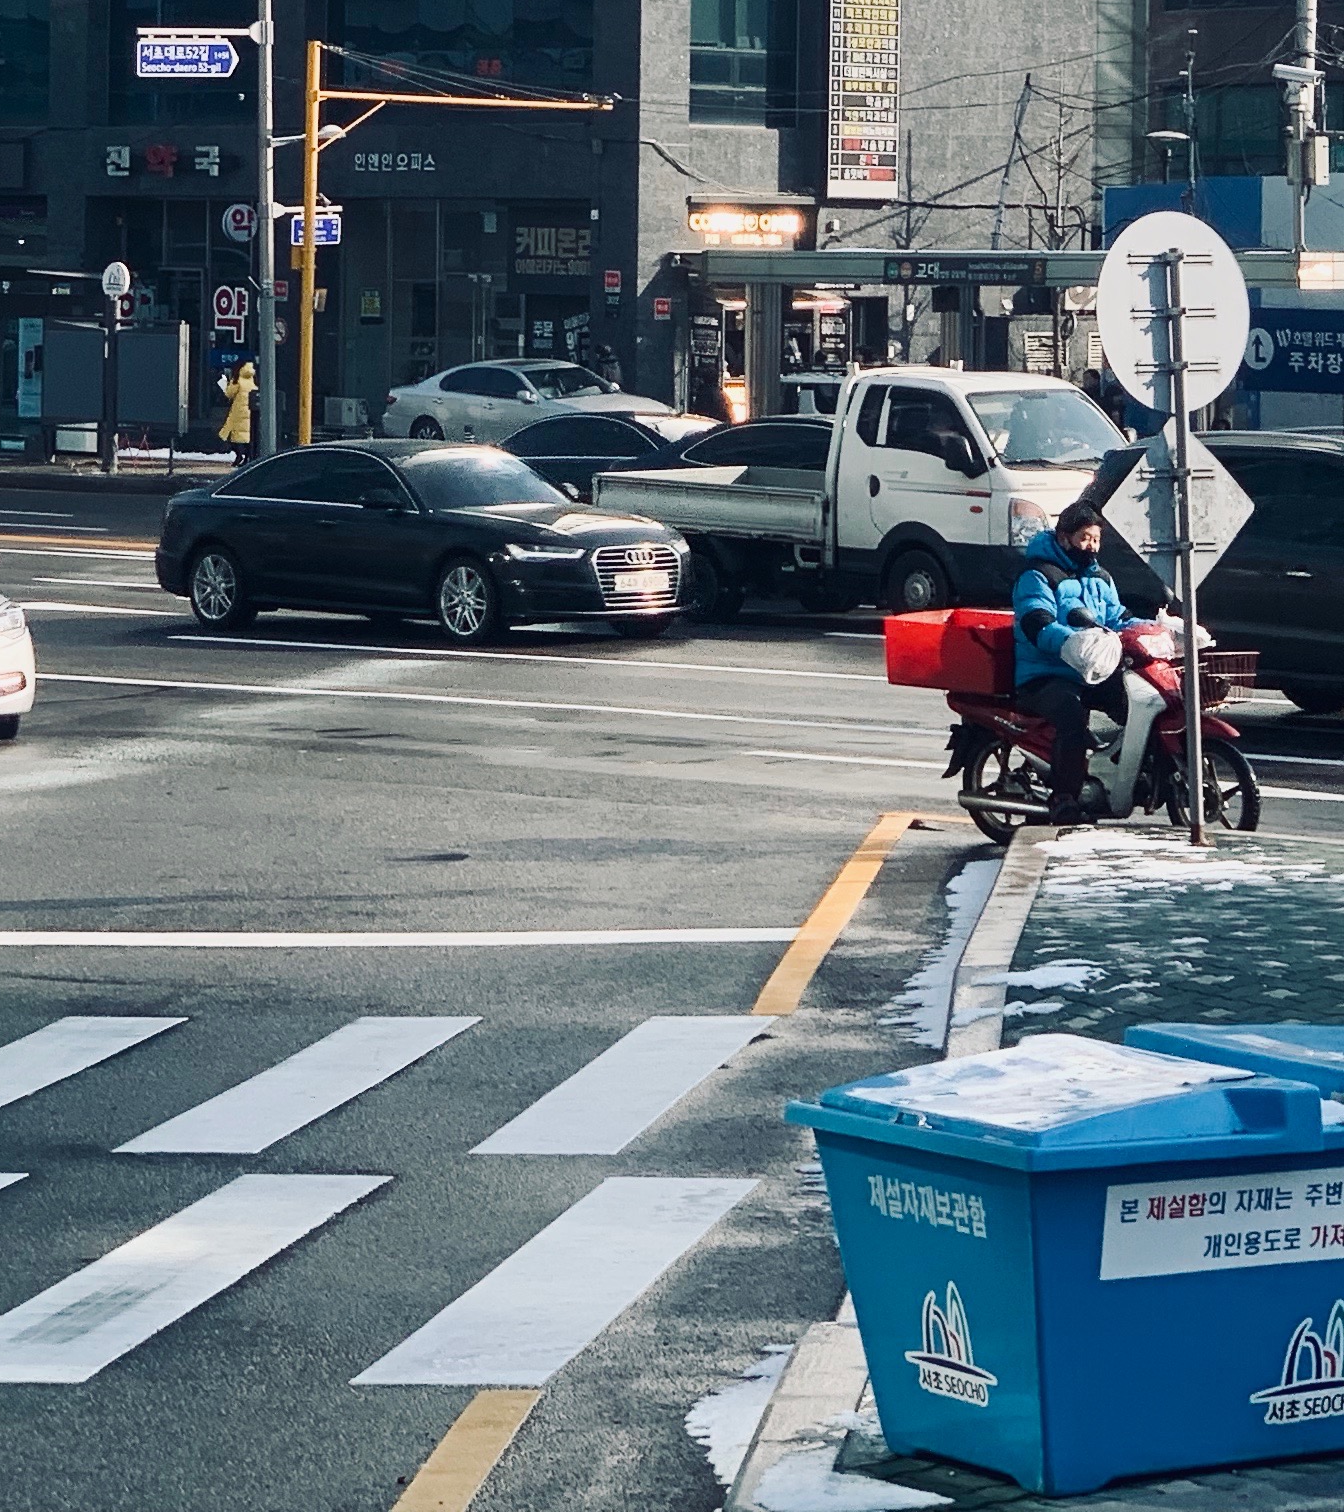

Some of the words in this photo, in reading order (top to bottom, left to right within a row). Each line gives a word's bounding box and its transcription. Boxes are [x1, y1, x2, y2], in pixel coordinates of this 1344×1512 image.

[395, 152, 436, 172] 오피스
[213, 285, 249, 344] 약
[1288, 351, 1343, 375] 주차장
[868, 1174, 987, 1239] 제설자재보관함
[1120, 1198, 1138, 1223] 본
[1146, 1192, 1225, 1221] 제설함의
[1234, 1187, 1293, 1214] 자재는
[1203, 1227, 1301, 1259] 개인용도로
[922, 1367, 943, 1390] 서초
[944, 1374, 986, 1404] SEOCHO
[1268, 1400, 1302, 1421] 서초
